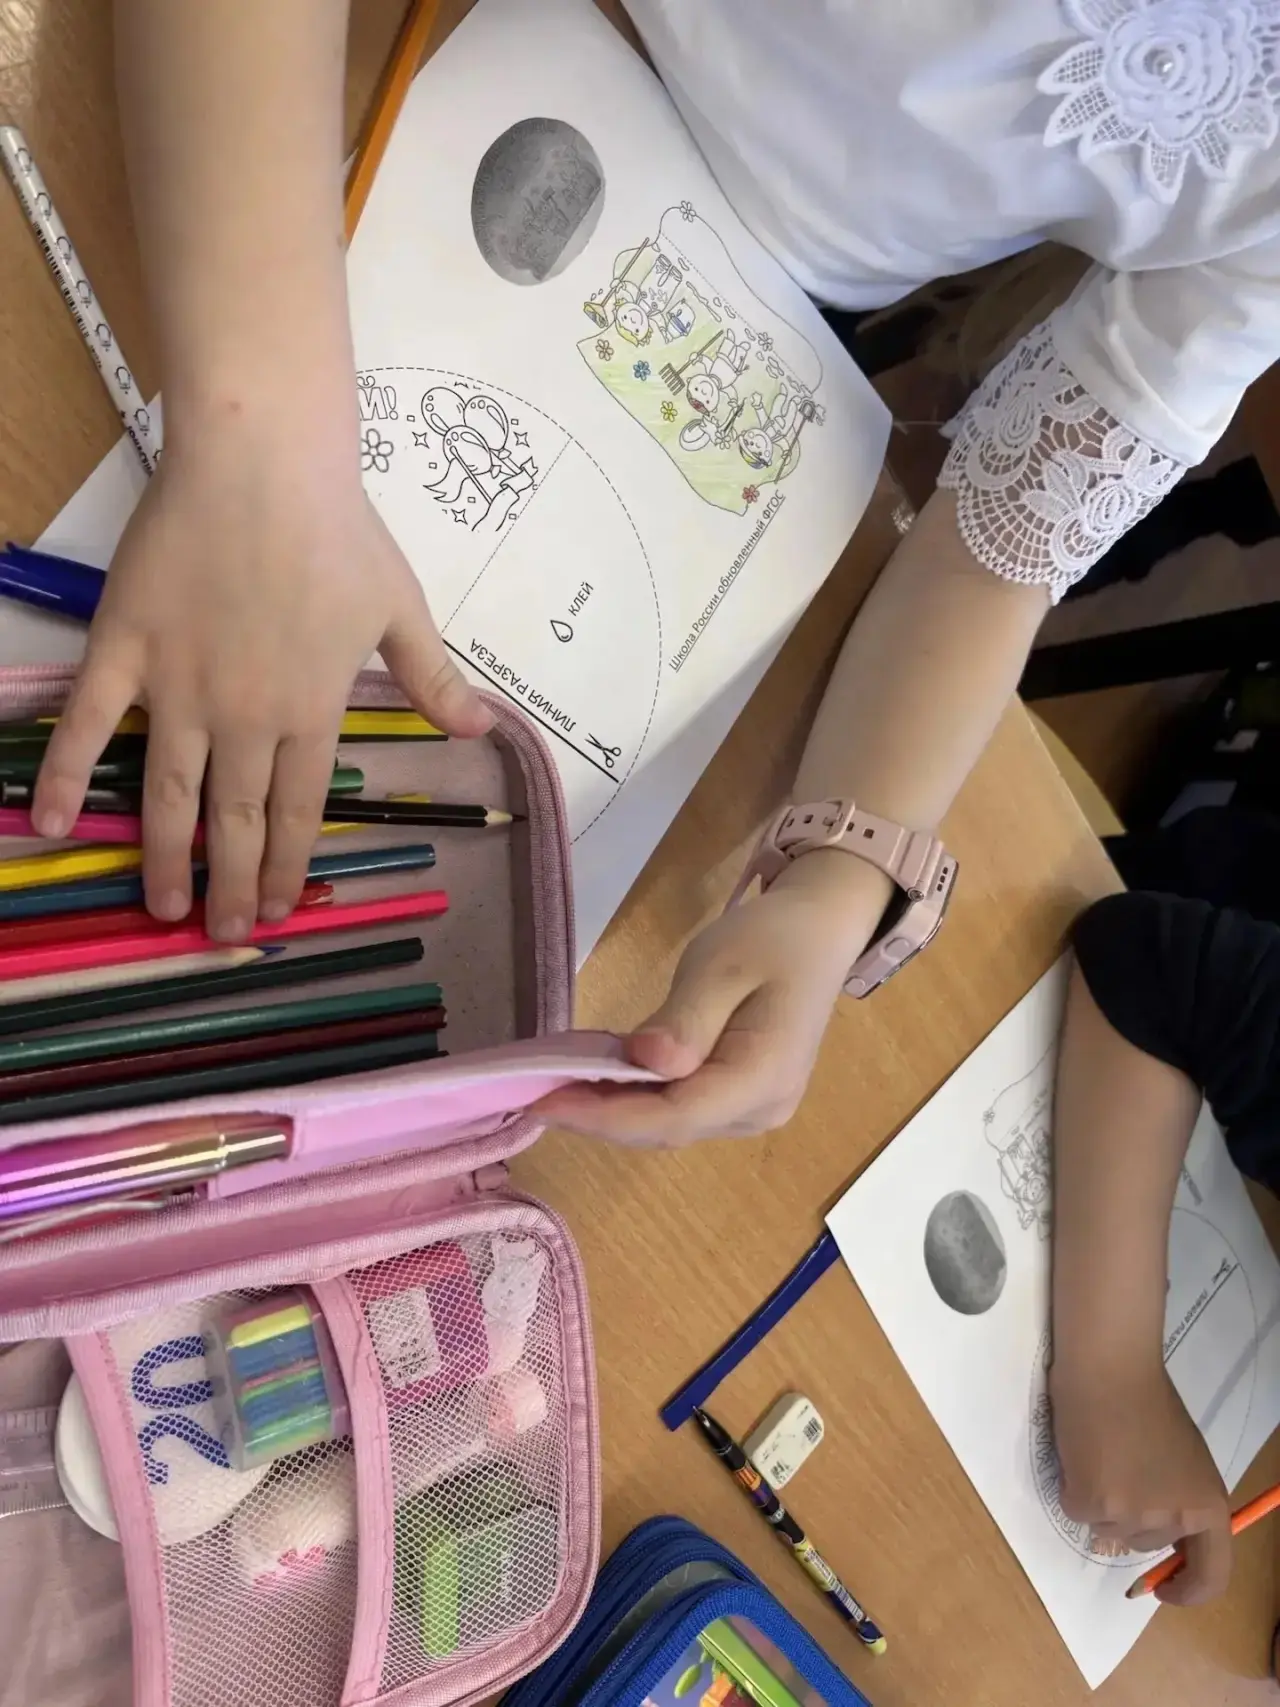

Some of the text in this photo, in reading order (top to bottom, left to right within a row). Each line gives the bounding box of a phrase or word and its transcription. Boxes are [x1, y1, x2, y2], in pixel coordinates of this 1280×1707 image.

[567, 581, 594, 617] КЛЕЙ
[668, 489, 785, 671] Школа России обновленный ФГОС
[469, 638, 577, 732] ЛИНИЯ РАЗРЕЗА
[131, 1334, 232, 1486] 20
